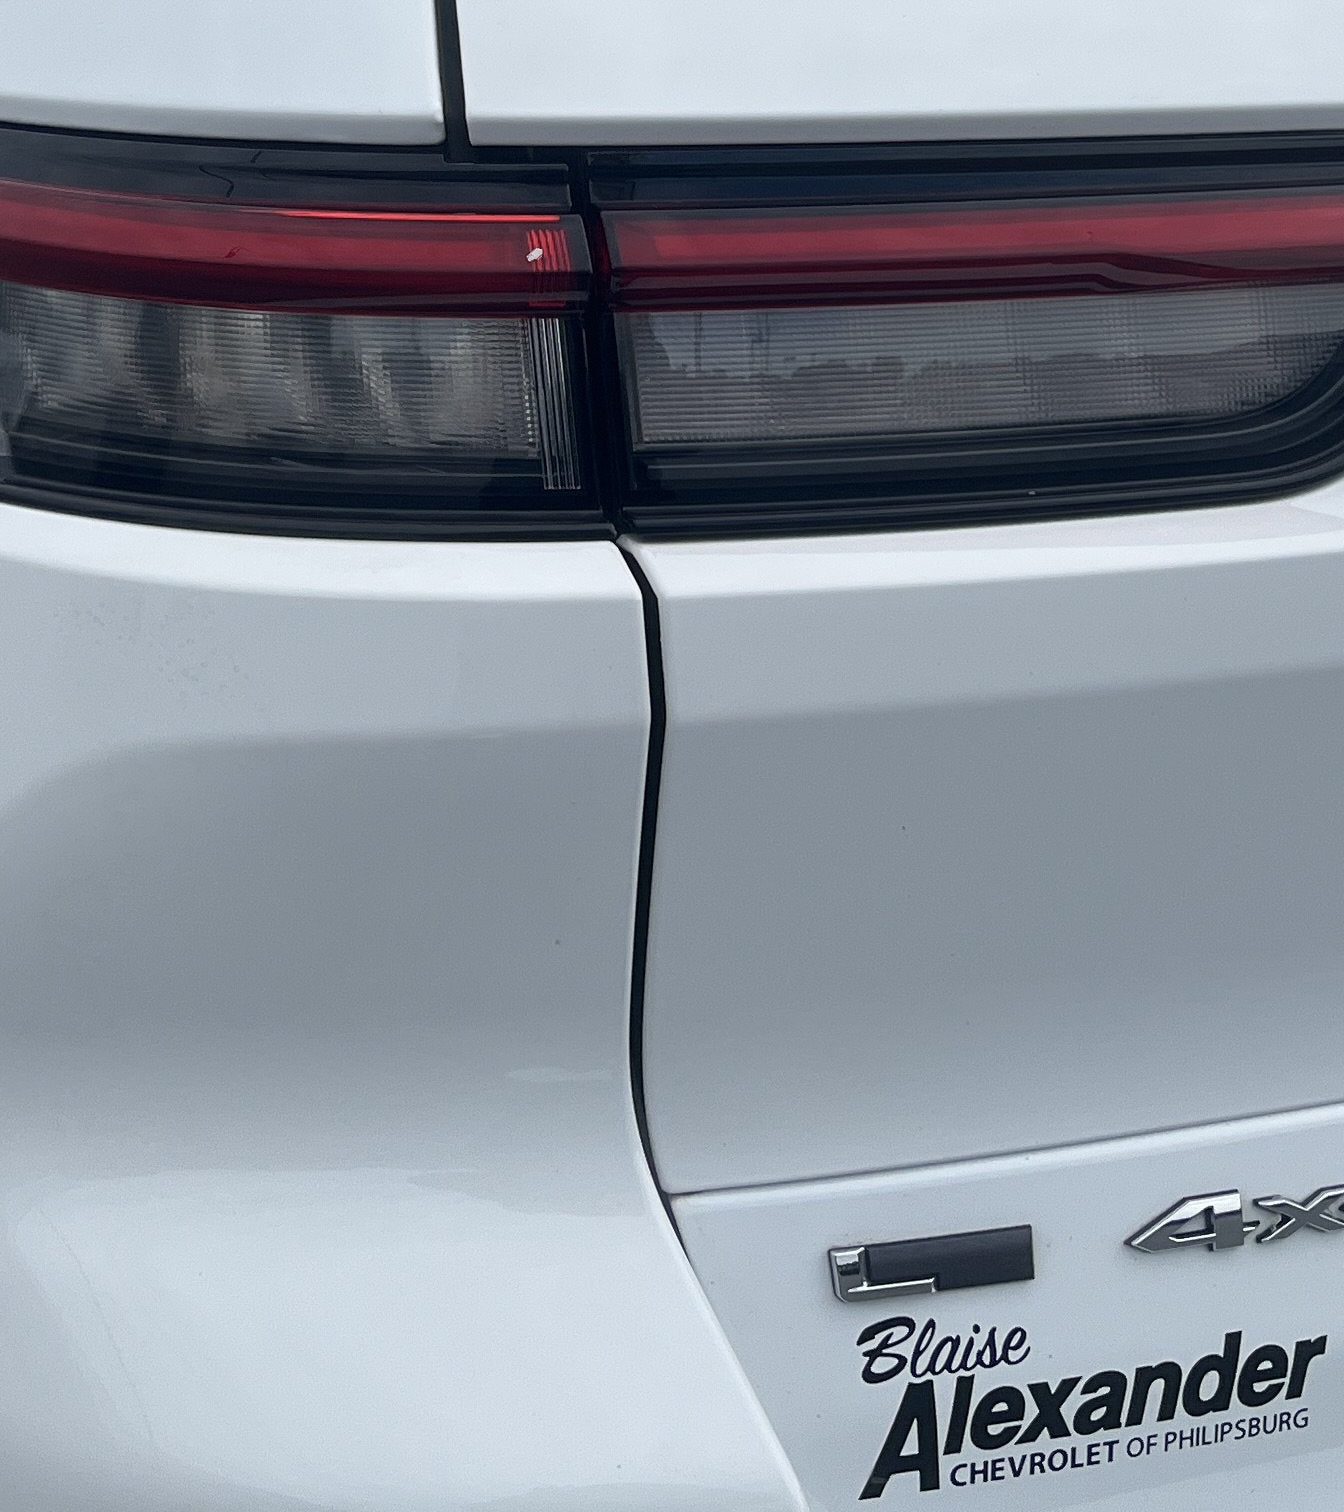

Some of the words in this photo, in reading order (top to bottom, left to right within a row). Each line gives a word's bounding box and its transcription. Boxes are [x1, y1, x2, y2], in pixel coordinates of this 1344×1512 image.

[856, 1316, 1031, 1384] Blaise
[858, 1331, 1327, 1500] Alexander
[949, 1439, 1119, 1486] CHEVROLET
[1126, 1434, 1157, 1459] OF
[1163, 1408, 1310, 1452] PHILIPSBURG
